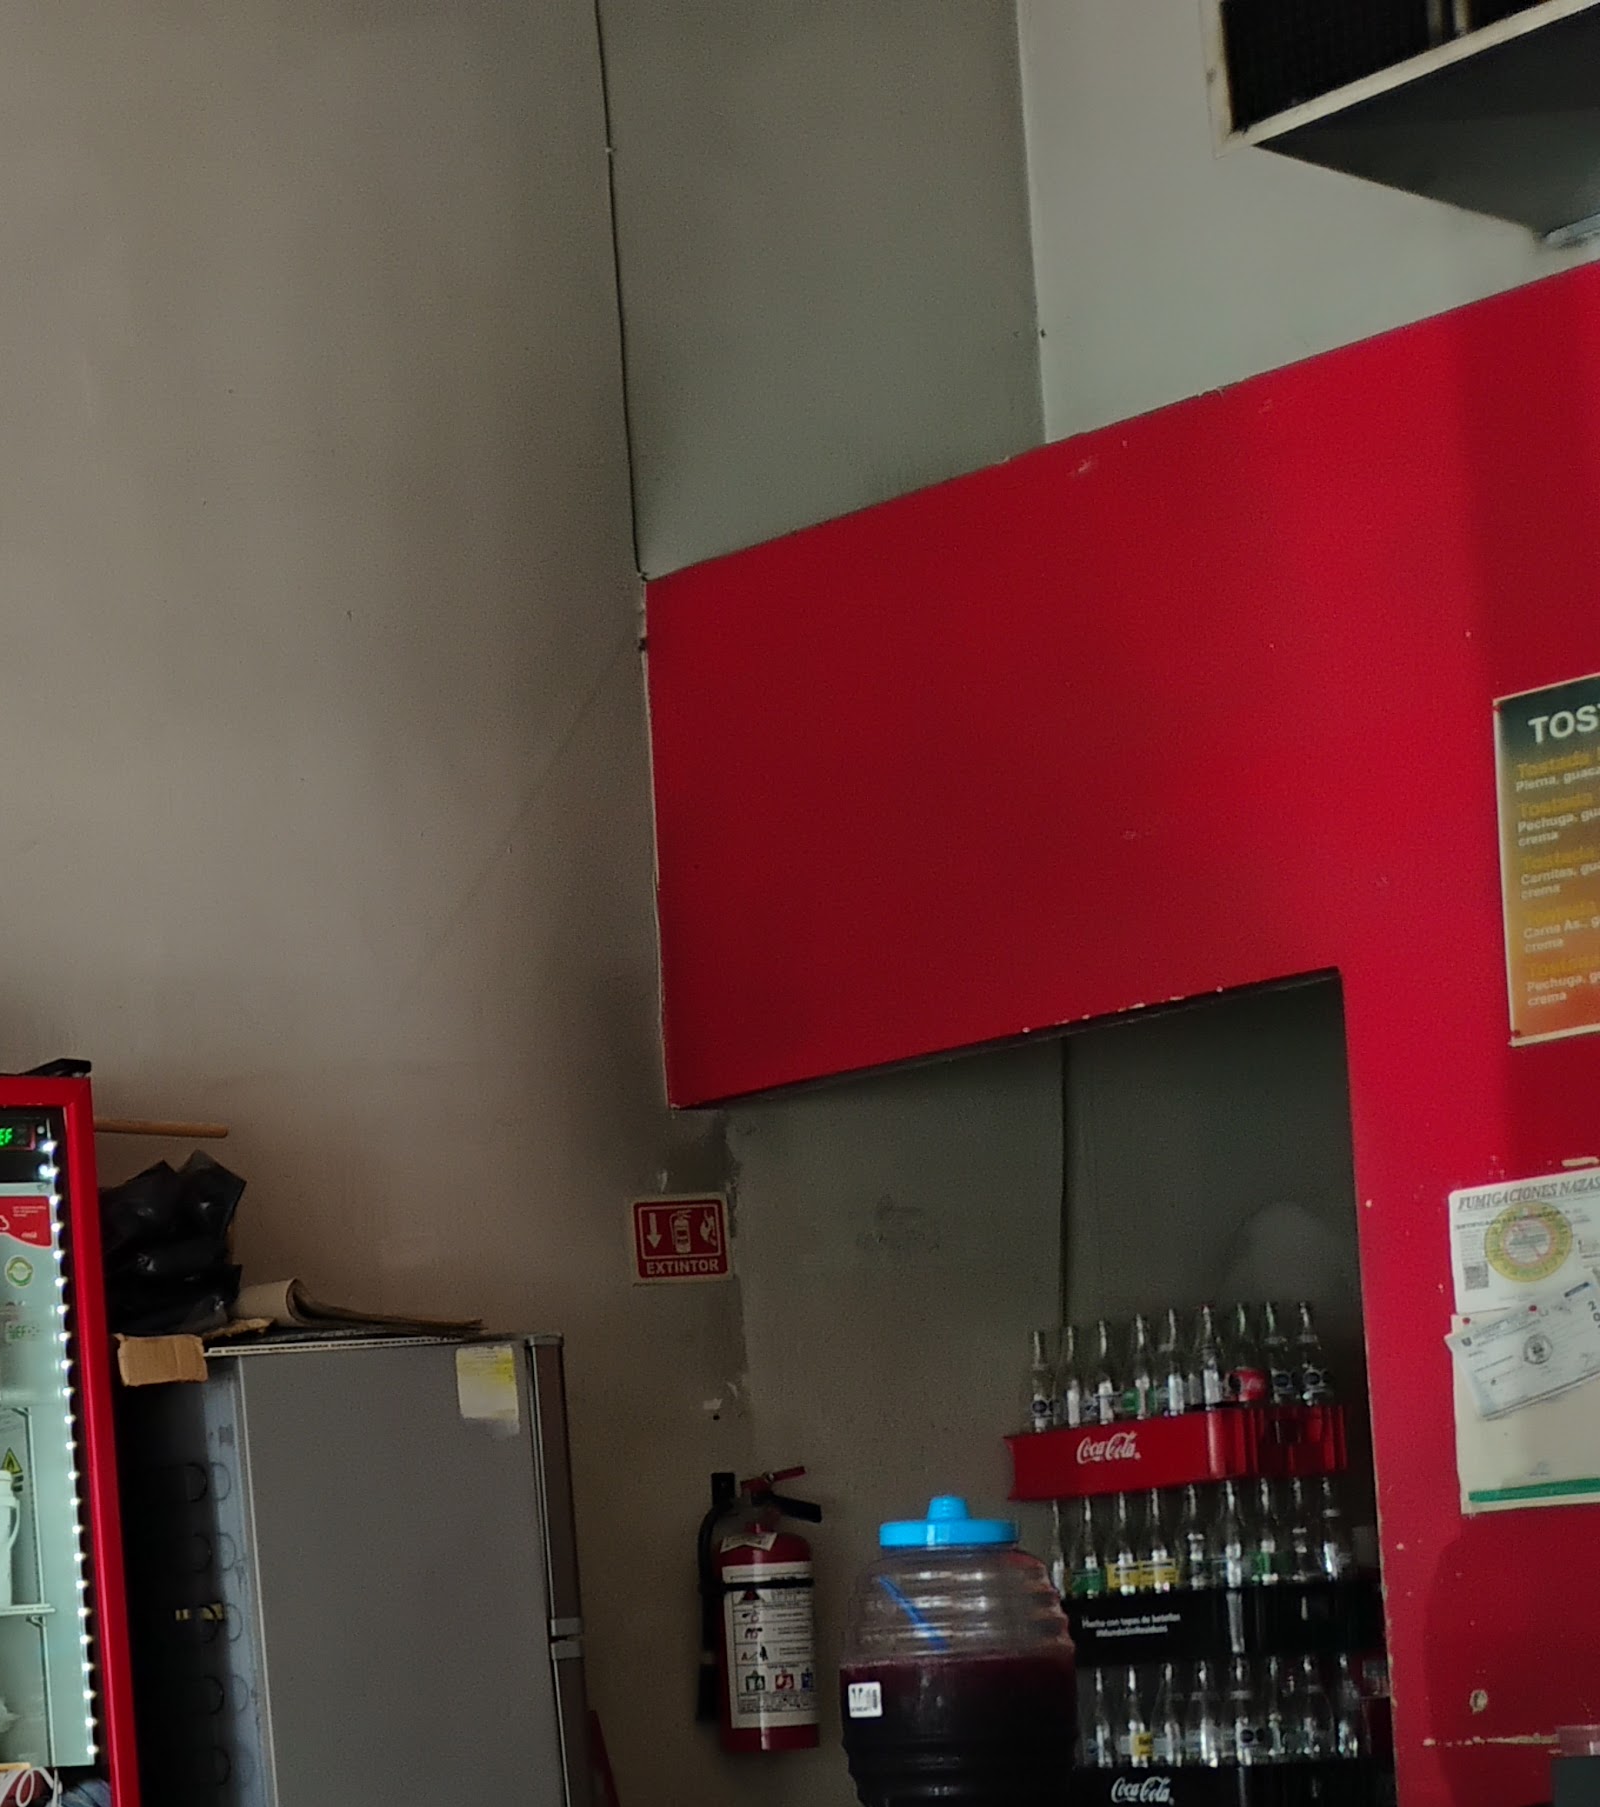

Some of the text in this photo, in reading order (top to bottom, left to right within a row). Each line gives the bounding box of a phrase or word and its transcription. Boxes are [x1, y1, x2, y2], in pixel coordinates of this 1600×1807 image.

[1528, 703, 1600, 743] TOS
[1457, 1182, 1559, 1211] FUMIGACIONES
[646, 1258, 719, 1275] EXTINTOR
[1077, 1431, 1141, 1465] Coca-Cola
[1111, 1776, 1172, 1804] Coca-Cola
